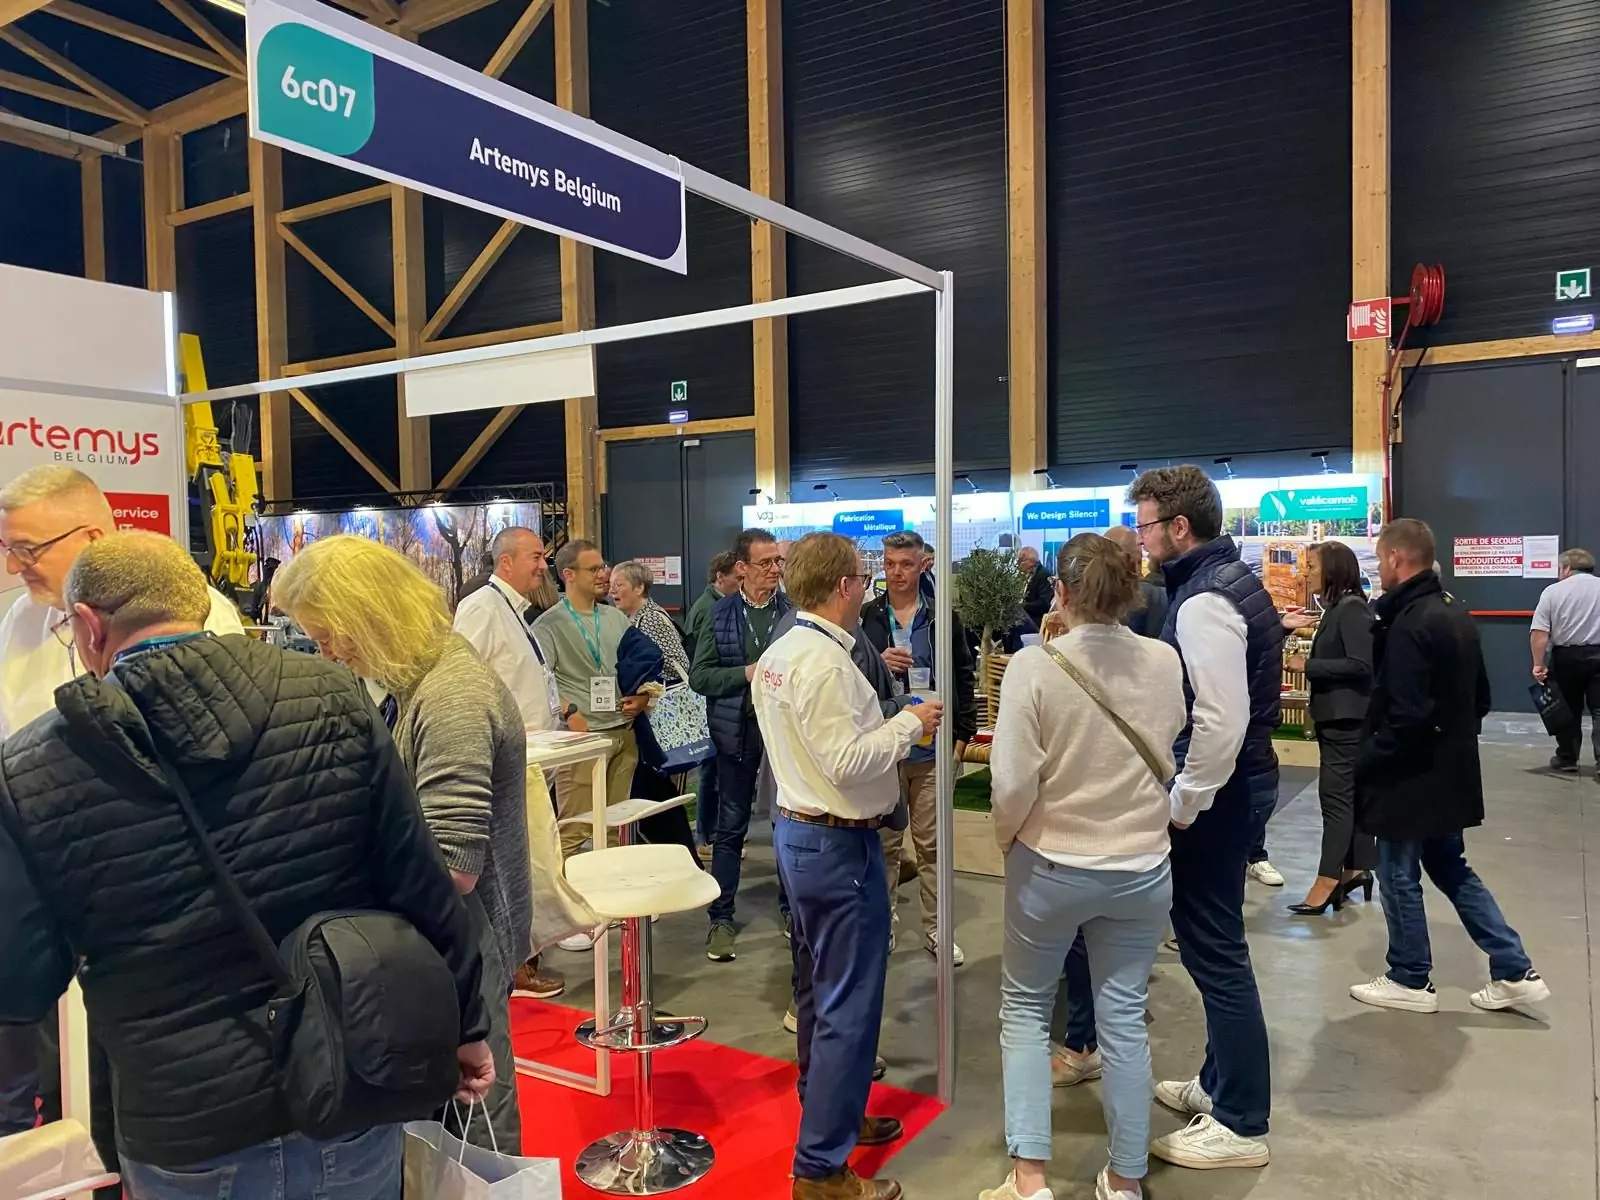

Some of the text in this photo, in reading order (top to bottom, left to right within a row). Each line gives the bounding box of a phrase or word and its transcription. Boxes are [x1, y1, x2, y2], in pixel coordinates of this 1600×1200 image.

[280, 65, 357, 118] 6c07
[469, 137, 622, 214] Artemys Belgium
[54, 451, 128, 465] BELGIUM
[112, 506, 159, 519] ervice
[839, 514, 875, 523] Fabrication
[1026, 512, 1039, 520] We
[1040, 511, 1067, 520] Design
[1068, 509, 1098, 518] Silence
[1490, 537, 1522, 545] SECOURS
[1459, 557, 1518, 565] NOODUITGANG
